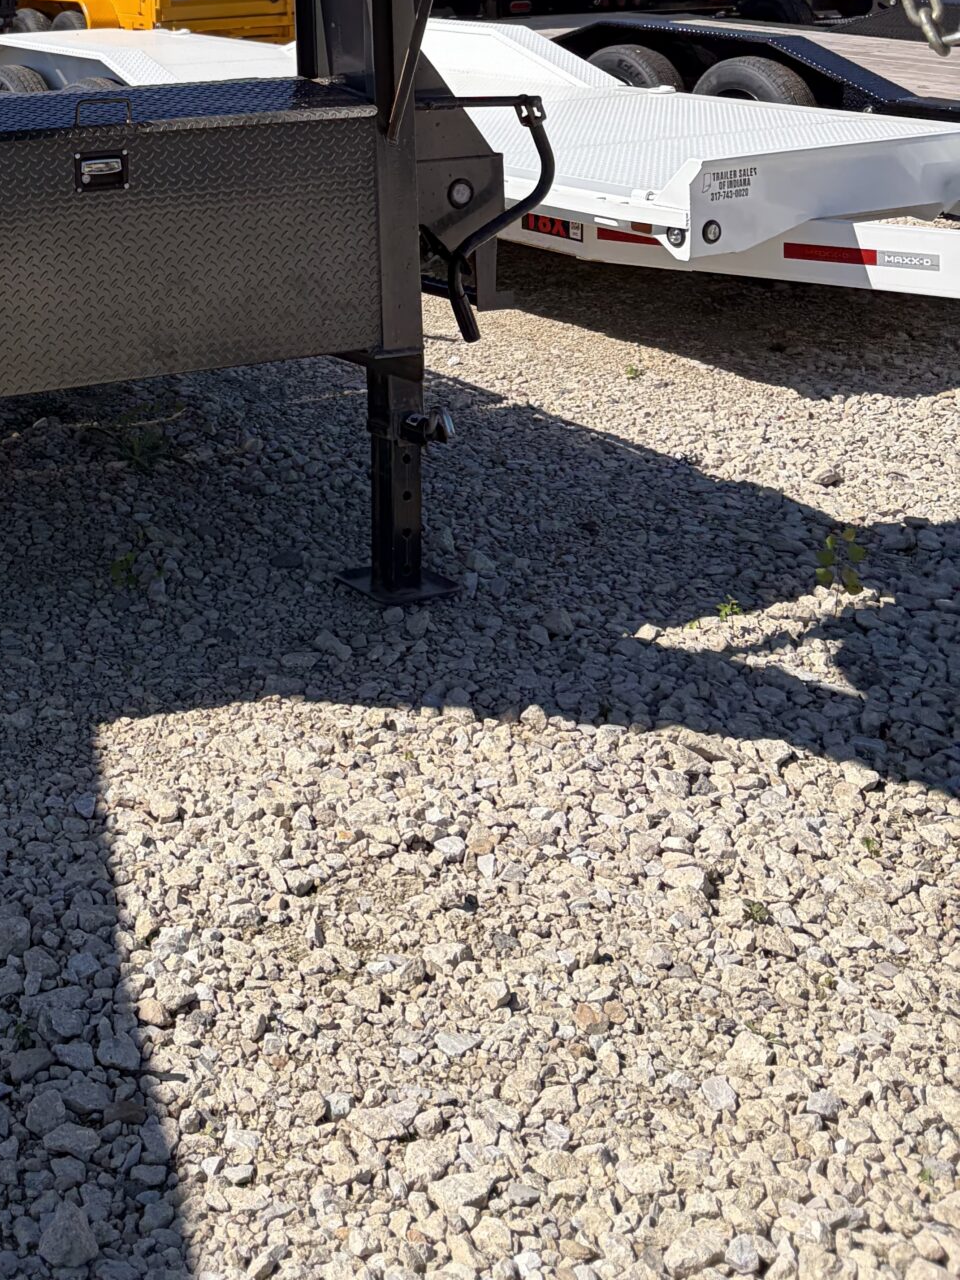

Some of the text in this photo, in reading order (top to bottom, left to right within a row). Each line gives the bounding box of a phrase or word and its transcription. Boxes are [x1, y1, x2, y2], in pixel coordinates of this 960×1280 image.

[712, 167, 757, 182] TRAILER SALES
[719, 178, 751, 190] OF INDIANA
[710, 188, 749, 201] 317-743-0020
[884, 255, 931, 266] MAXX-D
